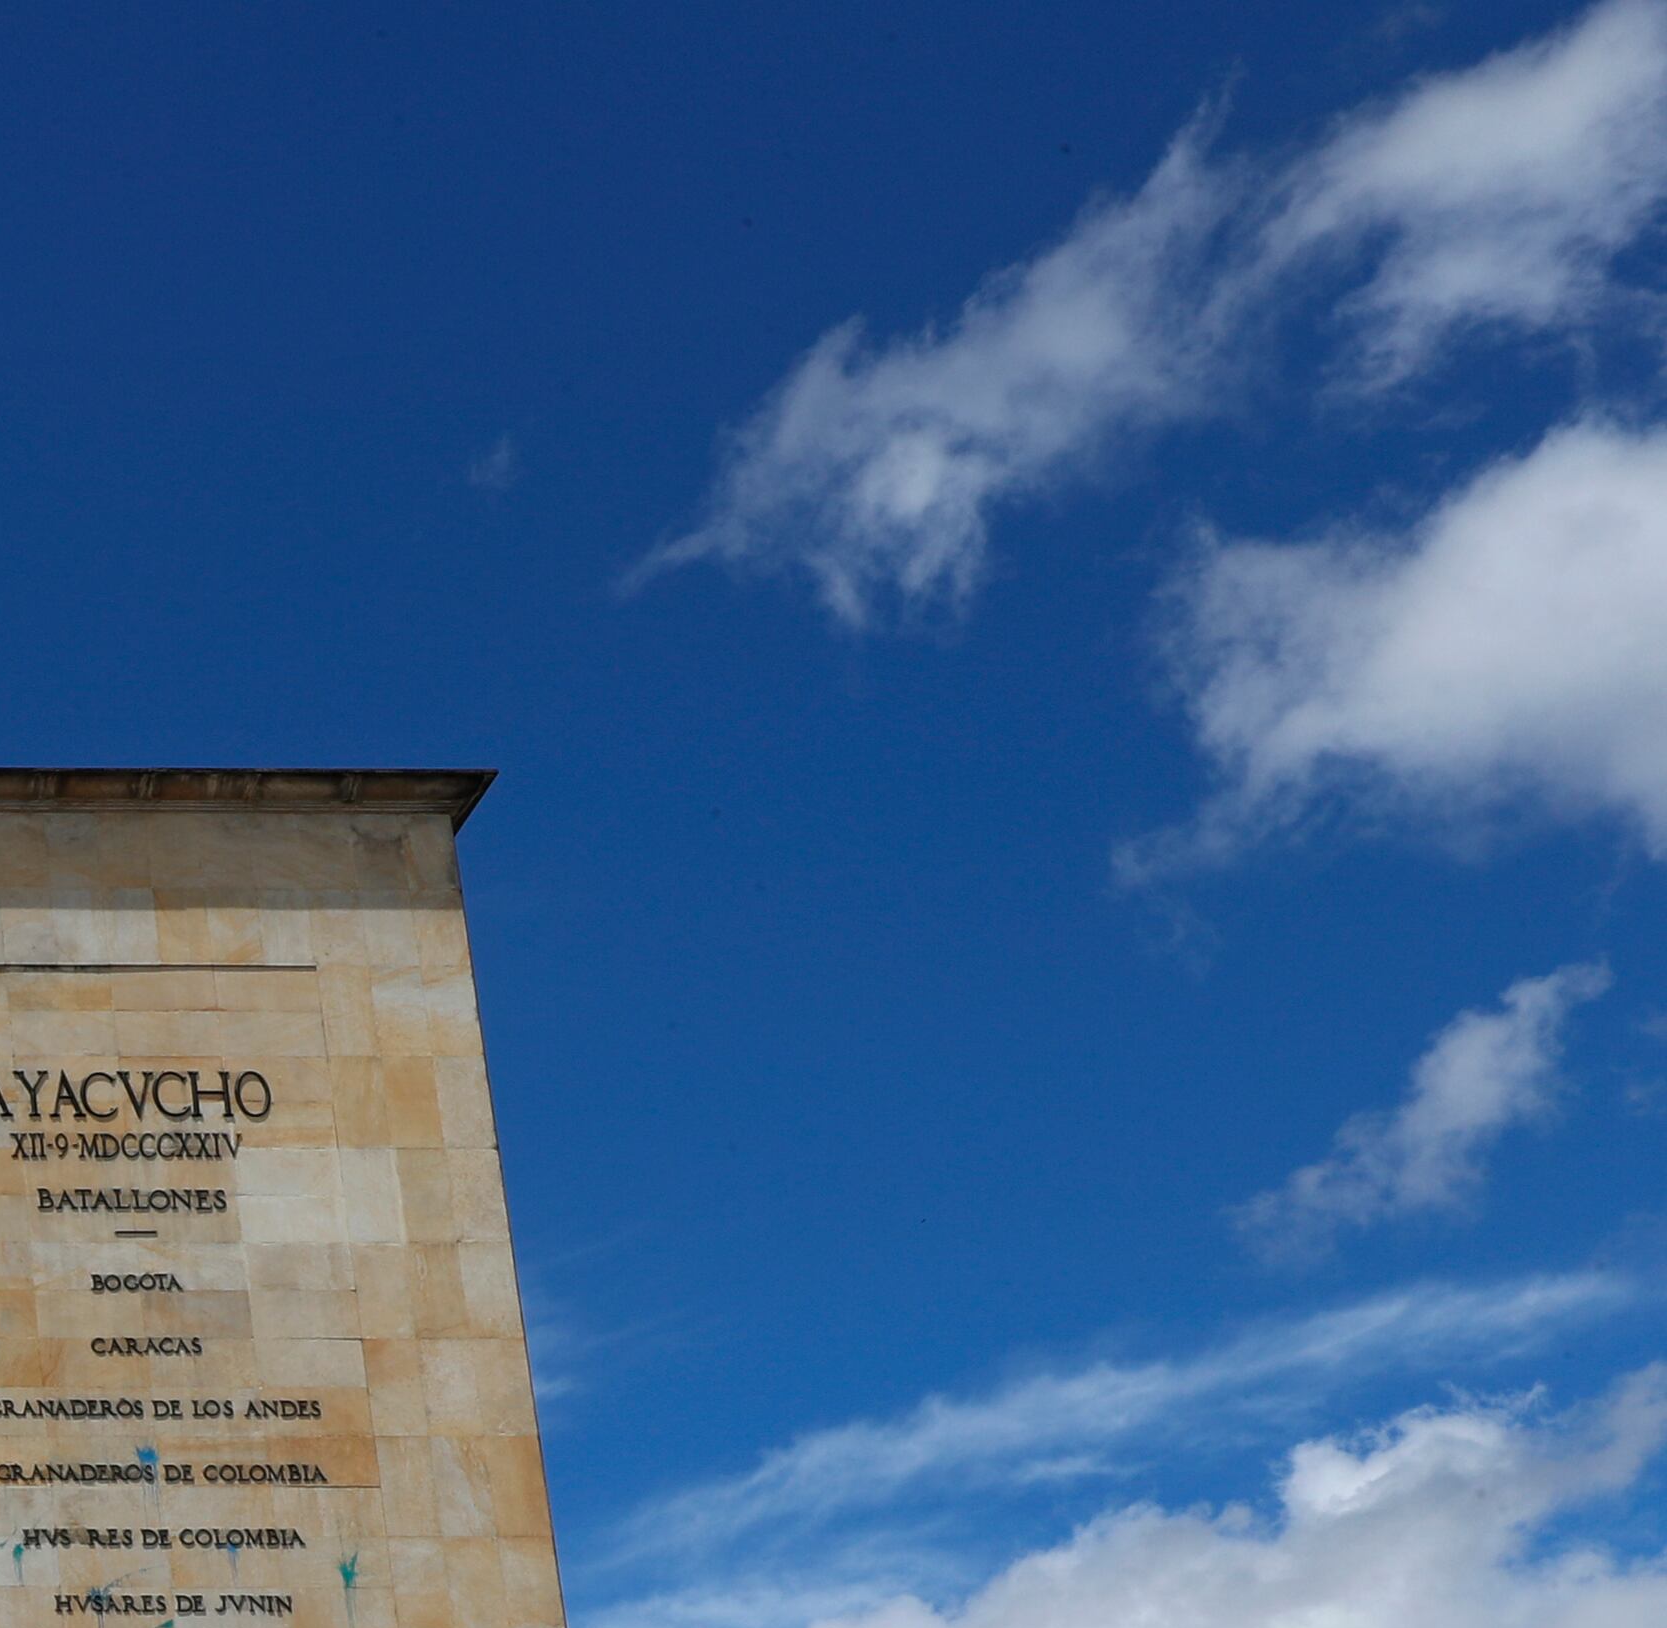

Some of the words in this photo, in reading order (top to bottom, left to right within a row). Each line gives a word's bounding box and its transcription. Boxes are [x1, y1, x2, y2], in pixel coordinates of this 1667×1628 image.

[37, 1189, 228, 1212] BATALLONES
[91, 1338, 202, 1356] CARACAS
[153, 1400, 183, 1418] DE
[192, 1400, 234, 1418] LOS
[244, 1400, 321, 1419] ANDES
[164, 1465, 194, 1483] DE
[203, 1465, 328, 1484] COLOMBIA
[141, 1528, 172, 1548] DE
[179, 1528, 306, 1548] COLOMBIA
[54, 1595, 166, 1615] HVSARES
[174, 1595, 205, 1616] DE
[216, 1595, 293, 1617] JVNIN
